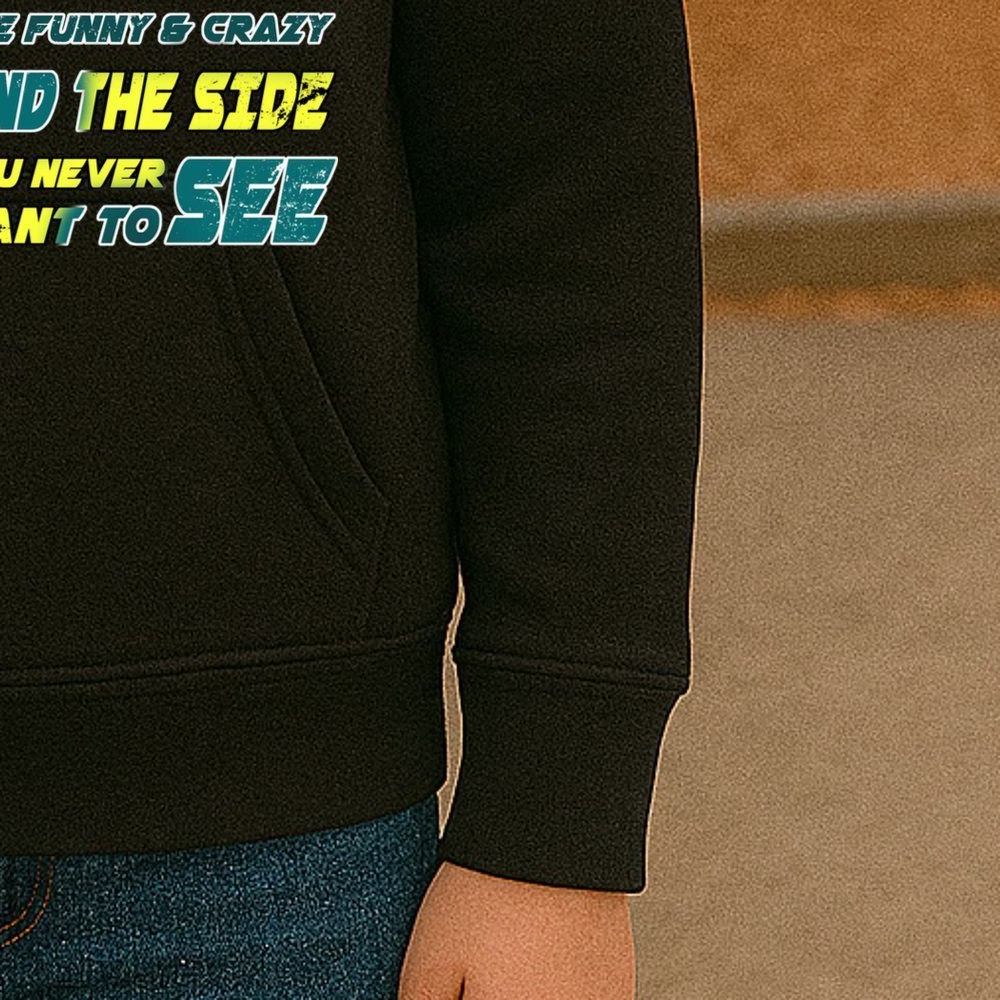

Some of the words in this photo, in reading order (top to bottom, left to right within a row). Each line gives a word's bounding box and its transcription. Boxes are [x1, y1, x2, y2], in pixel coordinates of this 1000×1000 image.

[21, 13, 156, 45] FUNNY
[158, 13, 196, 45] &
[201, 13, 336, 45] CRAZY
[74, 71, 179, 132] THE
[188, 72, 335, 130] SIDE
[30, 158, 166, 188] NEVER
[97, 205, 162, 246] TO
[165, 156, 338, 246] SEE
